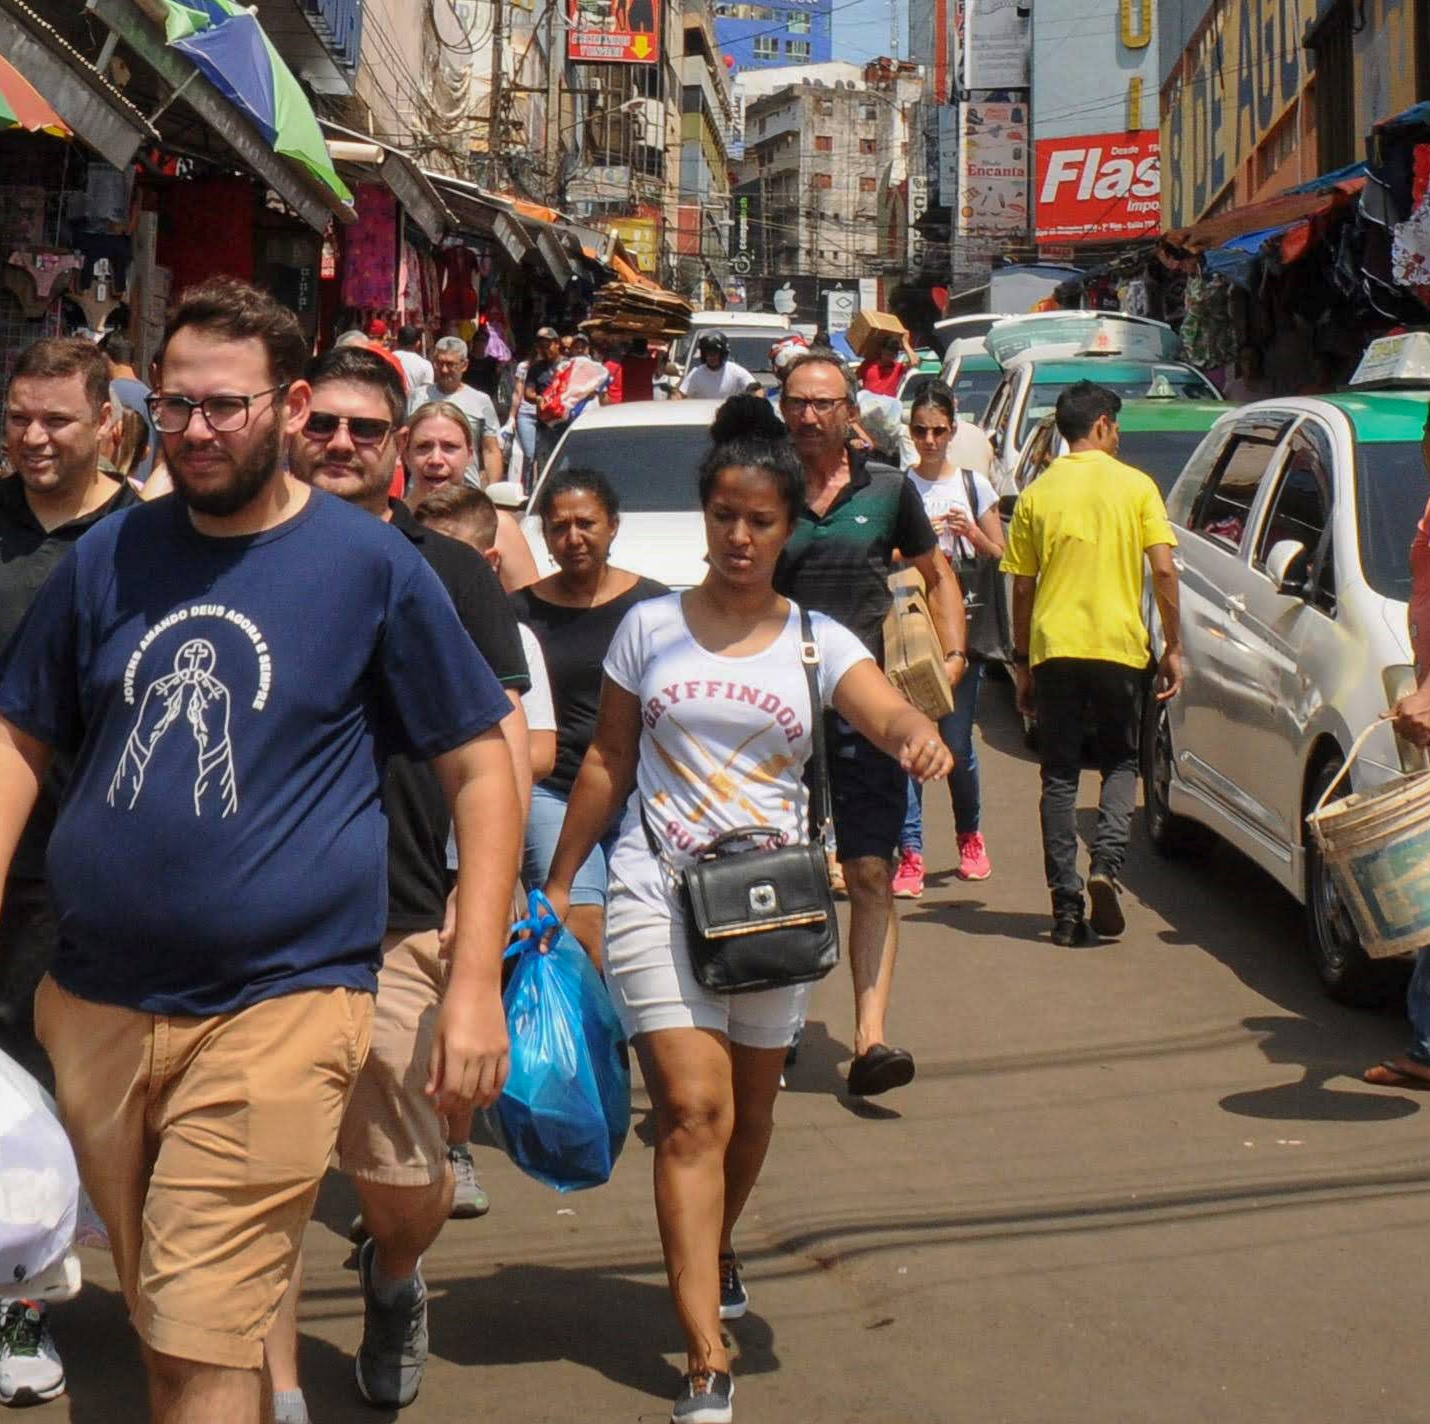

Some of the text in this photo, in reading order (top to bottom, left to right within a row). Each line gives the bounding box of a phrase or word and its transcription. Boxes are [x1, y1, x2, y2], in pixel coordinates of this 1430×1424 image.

[123, 604, 272, 711] JOVENS AMANDO DEUS AGORA E SEMPRE
[643, 680, 804, 744] GRYFFINDOR
